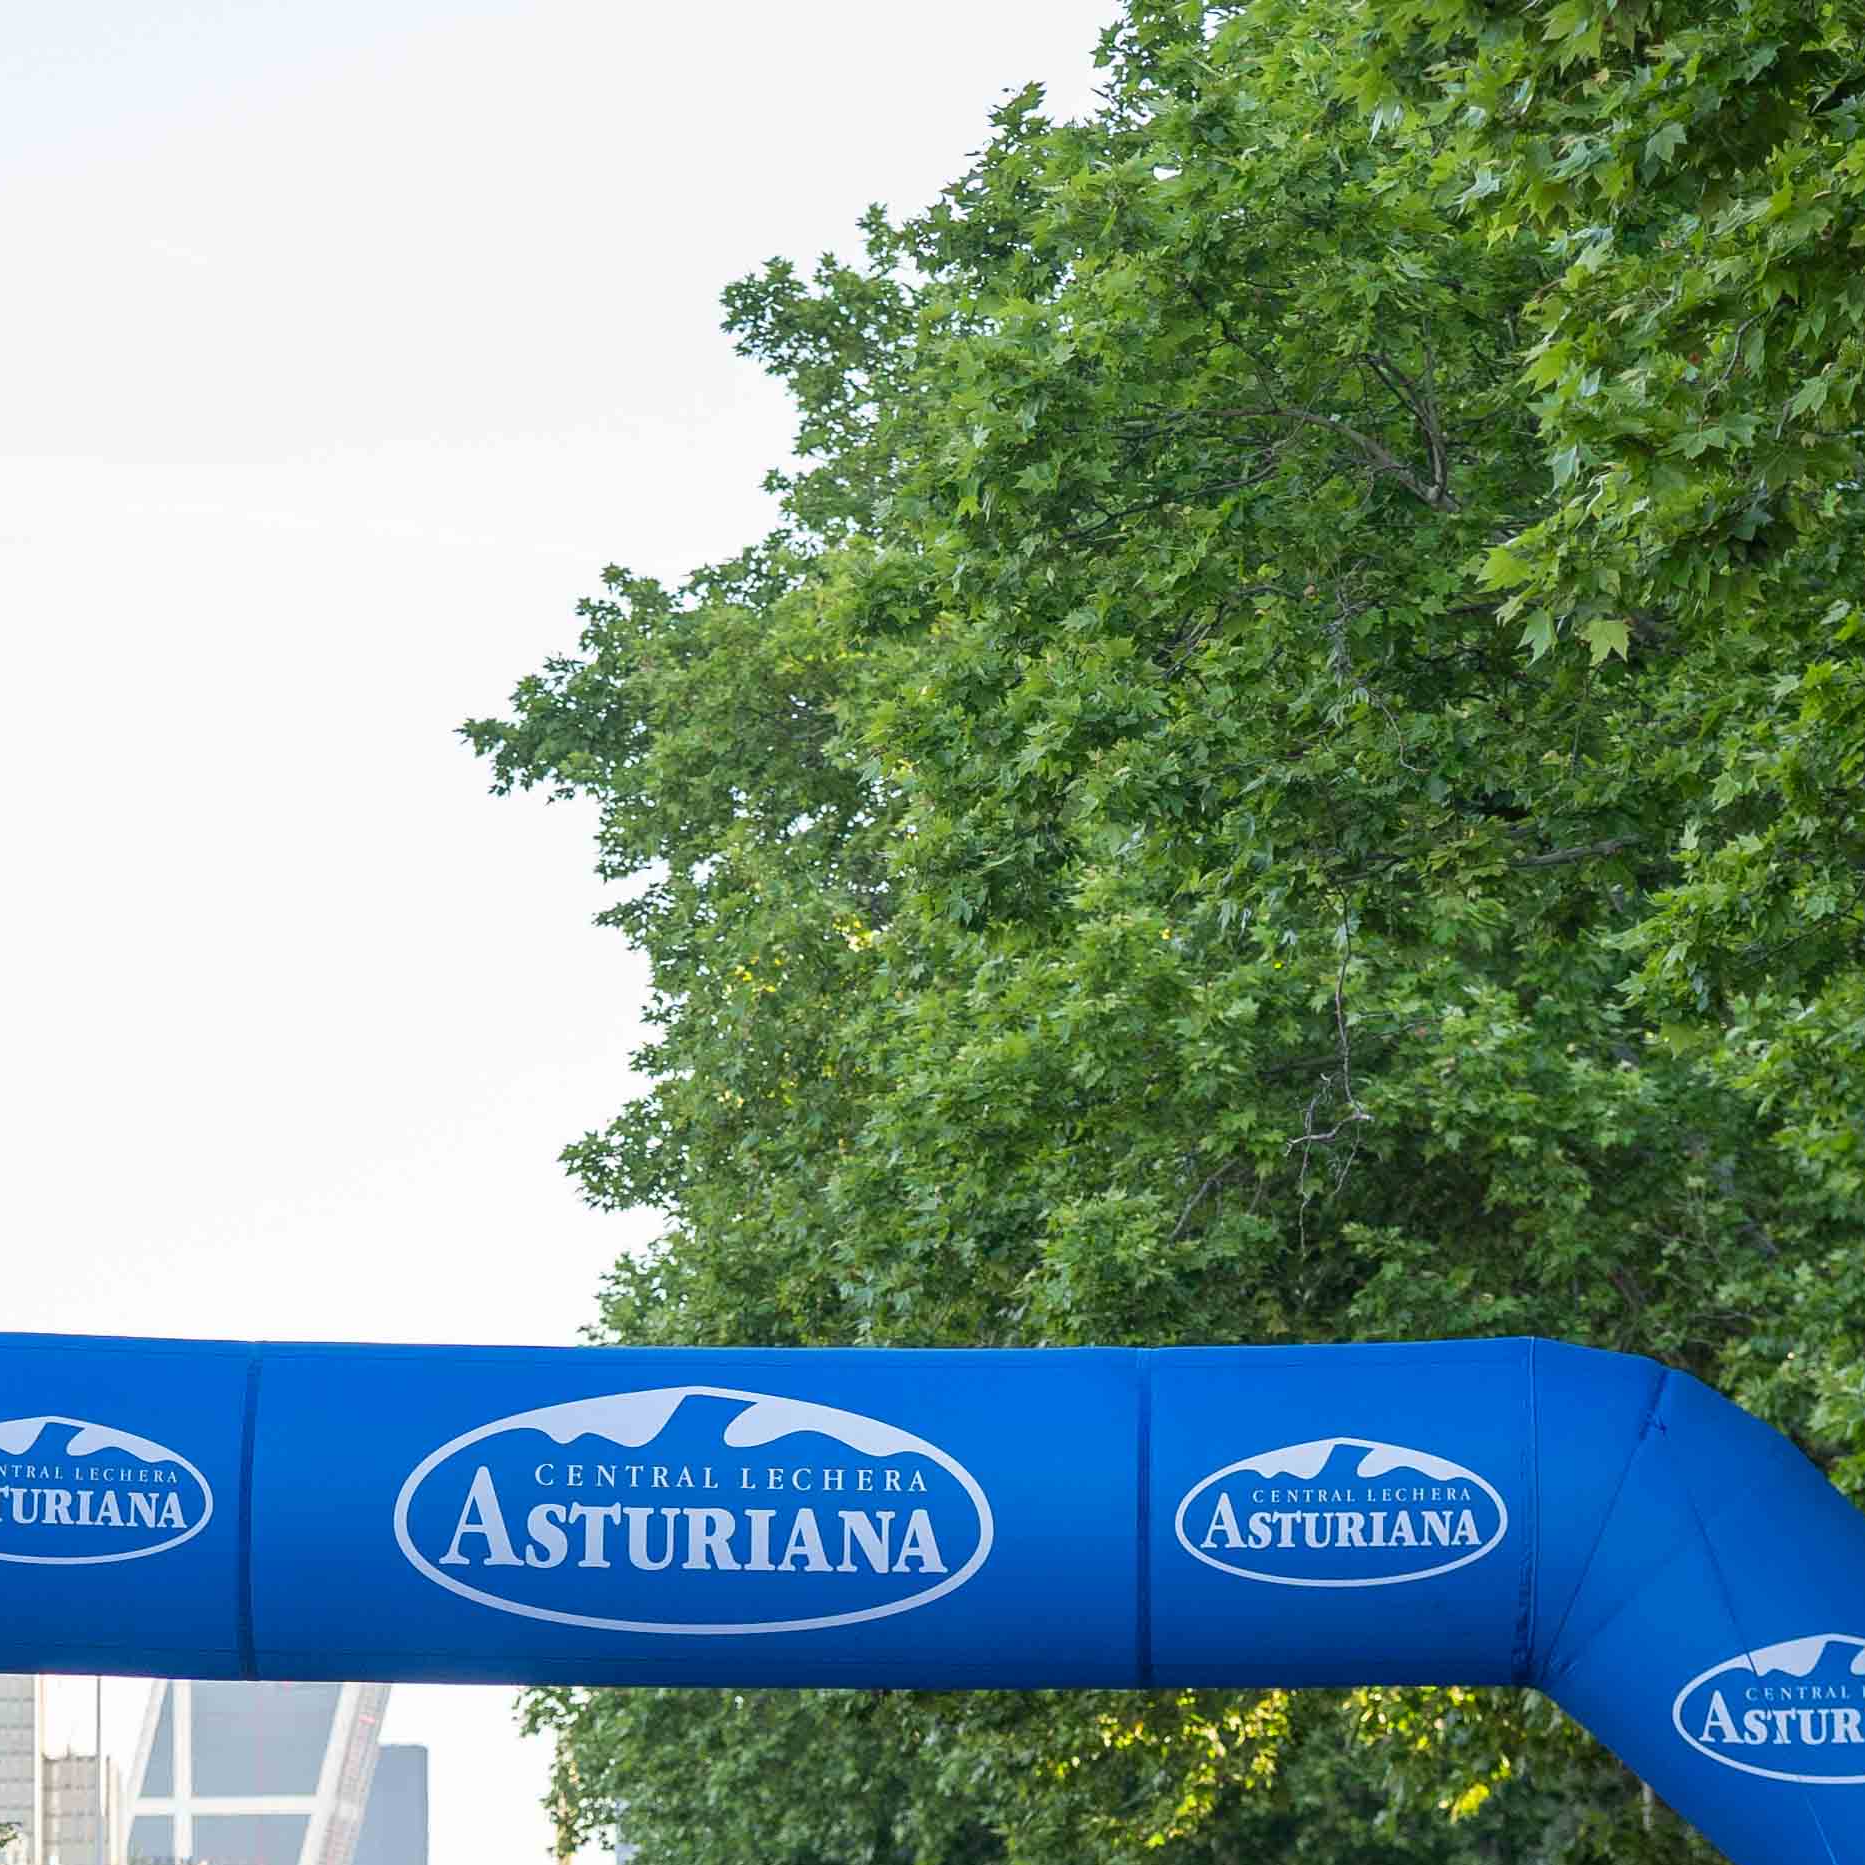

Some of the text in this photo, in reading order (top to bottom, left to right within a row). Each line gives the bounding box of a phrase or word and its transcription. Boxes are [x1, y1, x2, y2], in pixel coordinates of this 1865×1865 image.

[75, 1467, 178, 1483] LECHERA
[534, 1463, 928, 1493] CENTRAL LECHERA
[1253, 1486, 1472, 1503] CENTRAL LECHERA
[439, 1465, 949, 1574] ASTURIANA
[1200, 1492, 1482, 1549] ASTURIANA
[1745, 1687, 1849, 1701] CENTRAL
